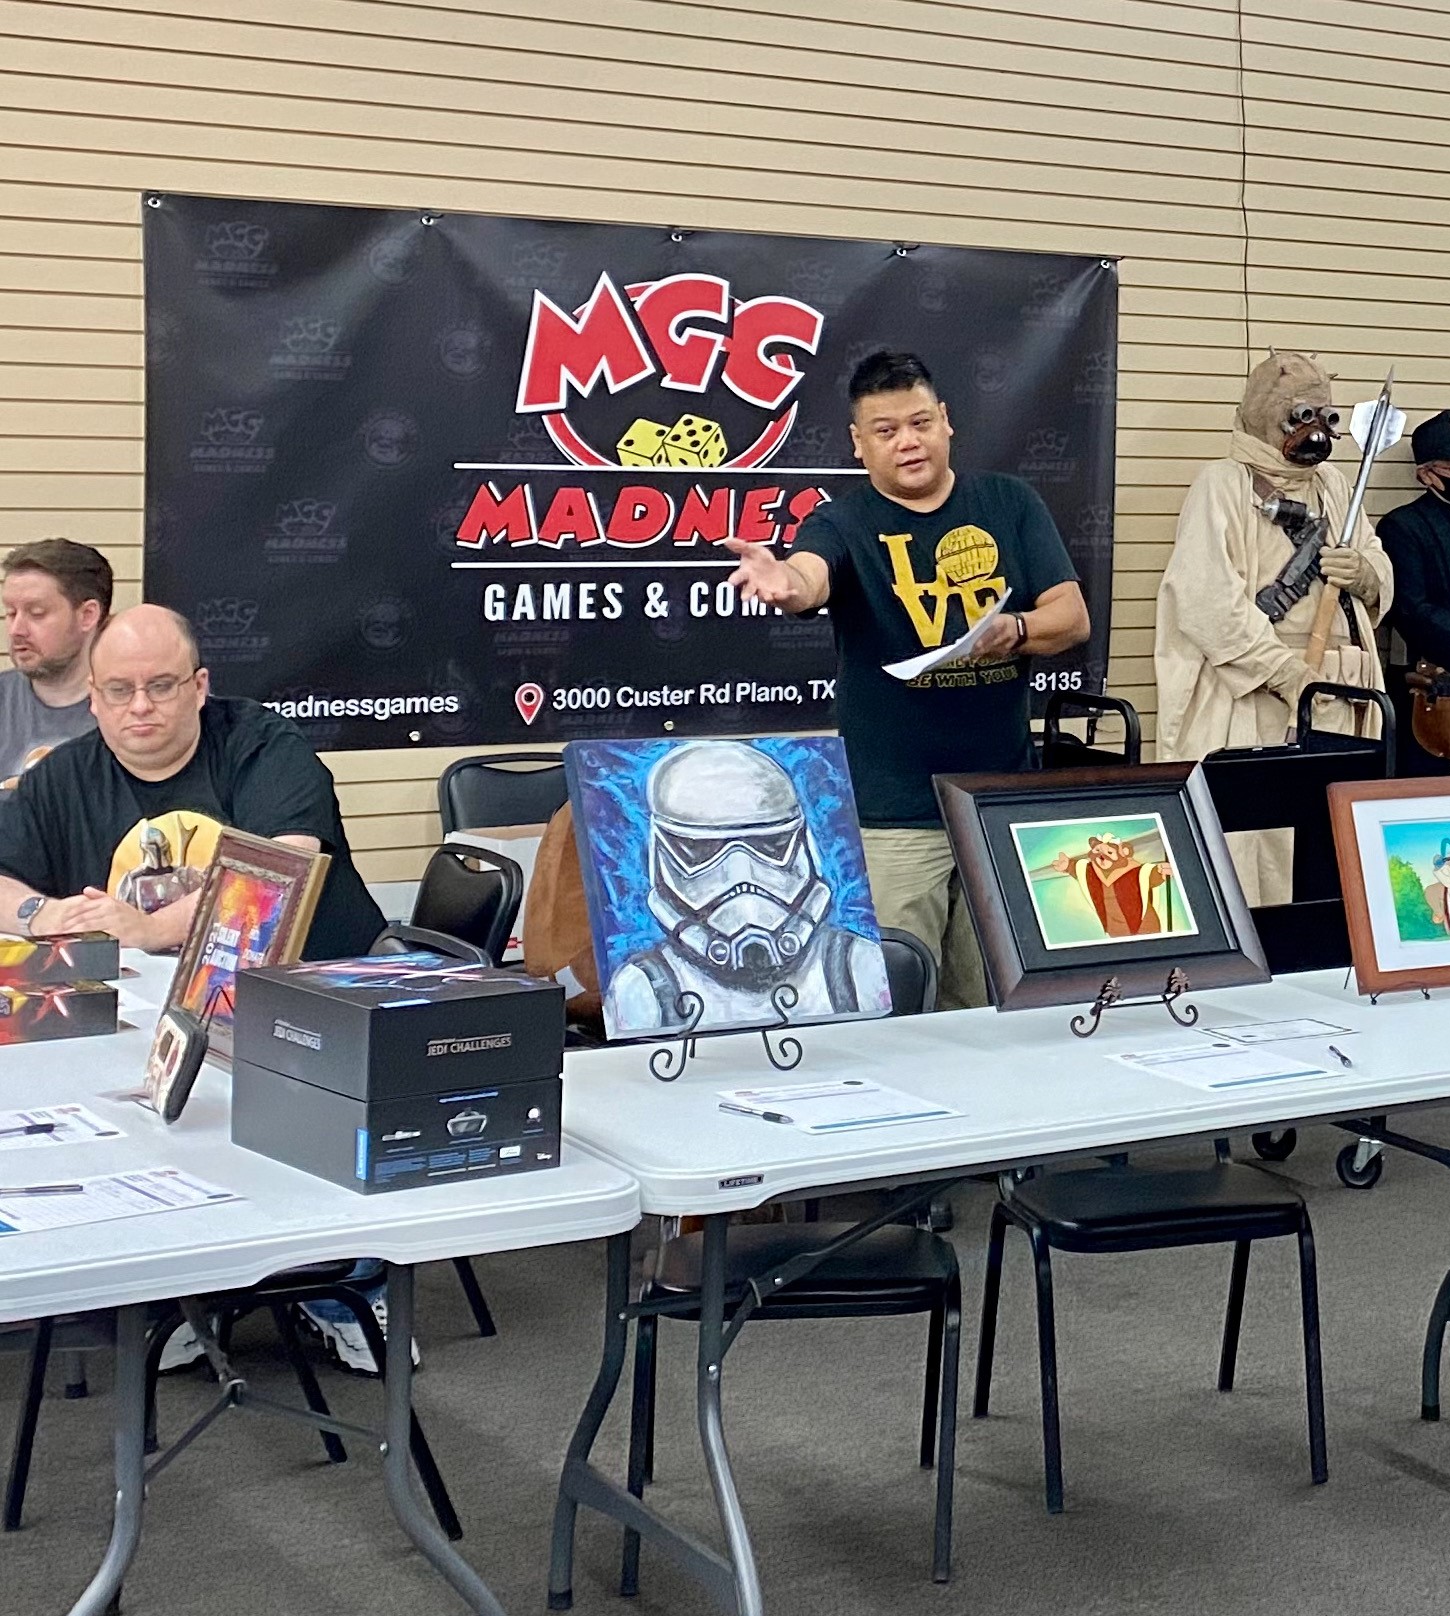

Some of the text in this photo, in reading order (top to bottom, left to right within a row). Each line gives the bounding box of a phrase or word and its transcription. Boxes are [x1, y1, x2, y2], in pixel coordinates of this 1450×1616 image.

[515, 270, 825, 414] MGC
[484, 582, 624, 621] GAMES
[644, 581, 670, 618] &
[935, 672, 977, 688] WITH
[1029, 671, 1082, 691] -8135
[552, 679, 836, 710] 3000 Custer Rd Plano, TX
[426, 1044, 448, 1057] JEDI
[450, 1037, 511, 1054] CHALLENGES
